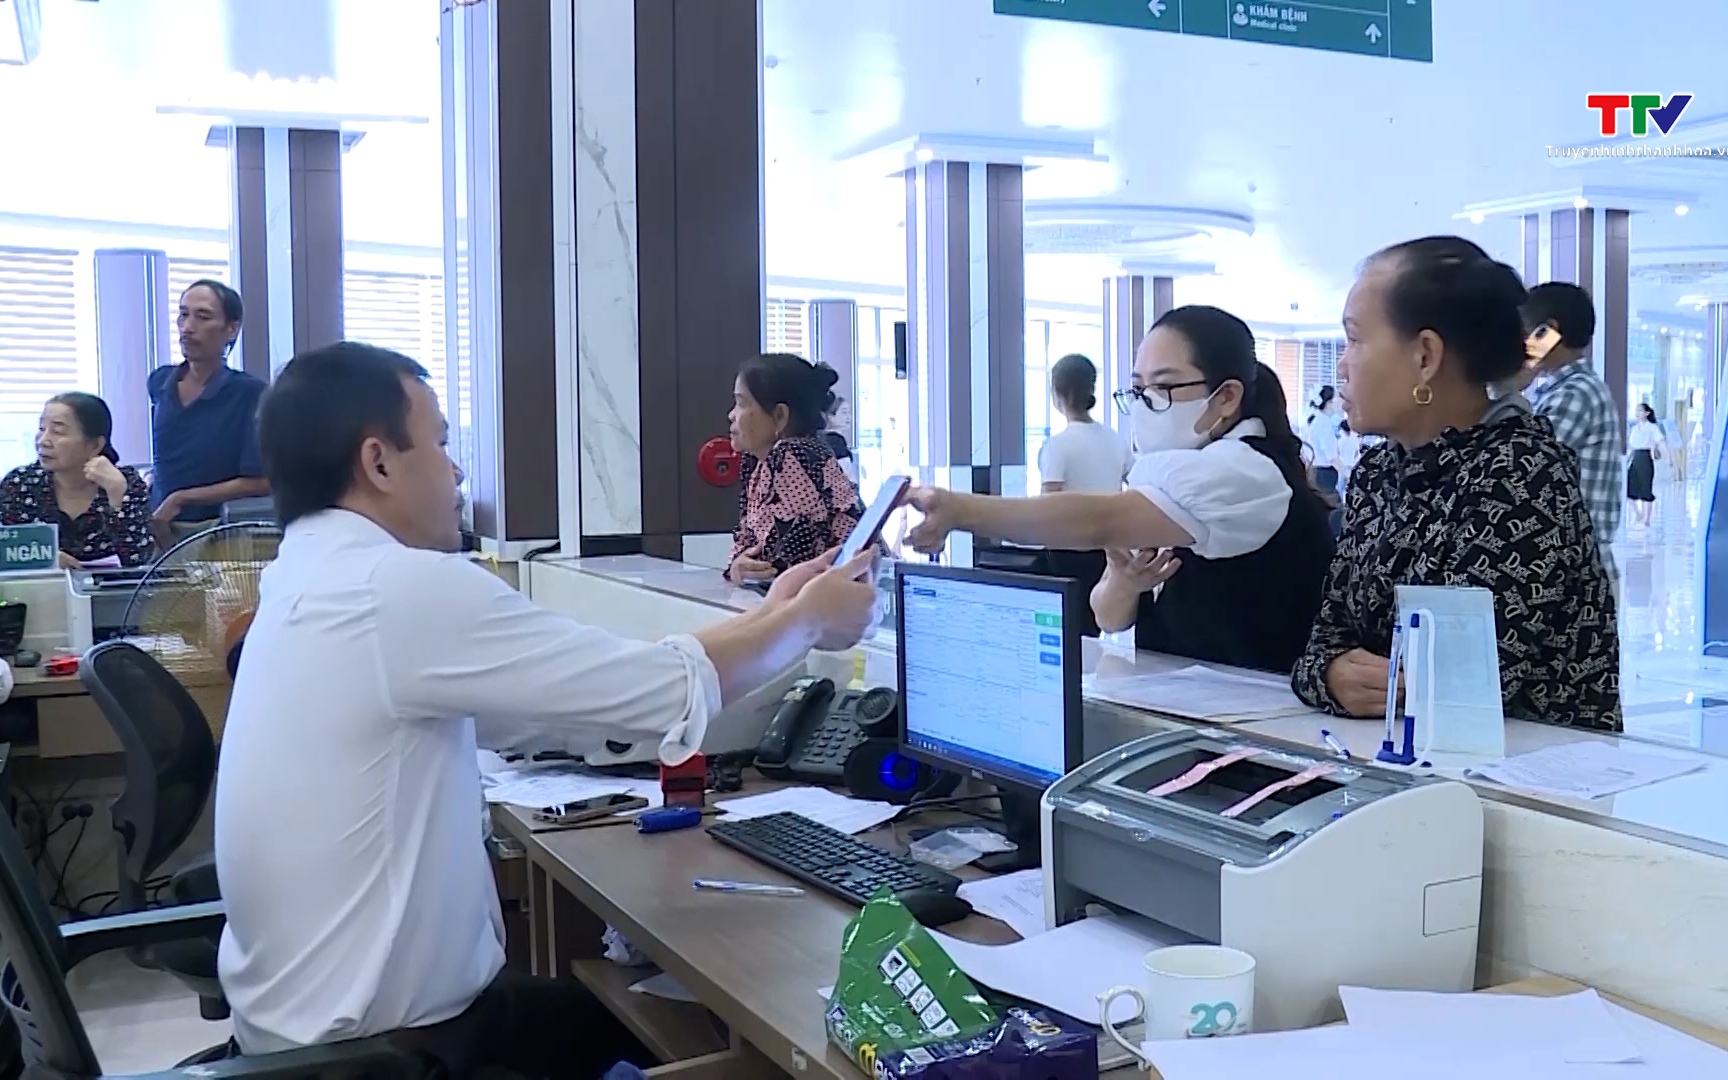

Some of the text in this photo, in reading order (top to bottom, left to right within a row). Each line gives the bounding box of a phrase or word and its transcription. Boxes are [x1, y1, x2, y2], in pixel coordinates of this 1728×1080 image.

[1249, 4, 1308, 22] KHÁM BỆNH
[1506, 515, 1542, 535] Dior
[6, 541, 52, 562] NGÂN
[1190, 1001, 1237, 1034] 20
